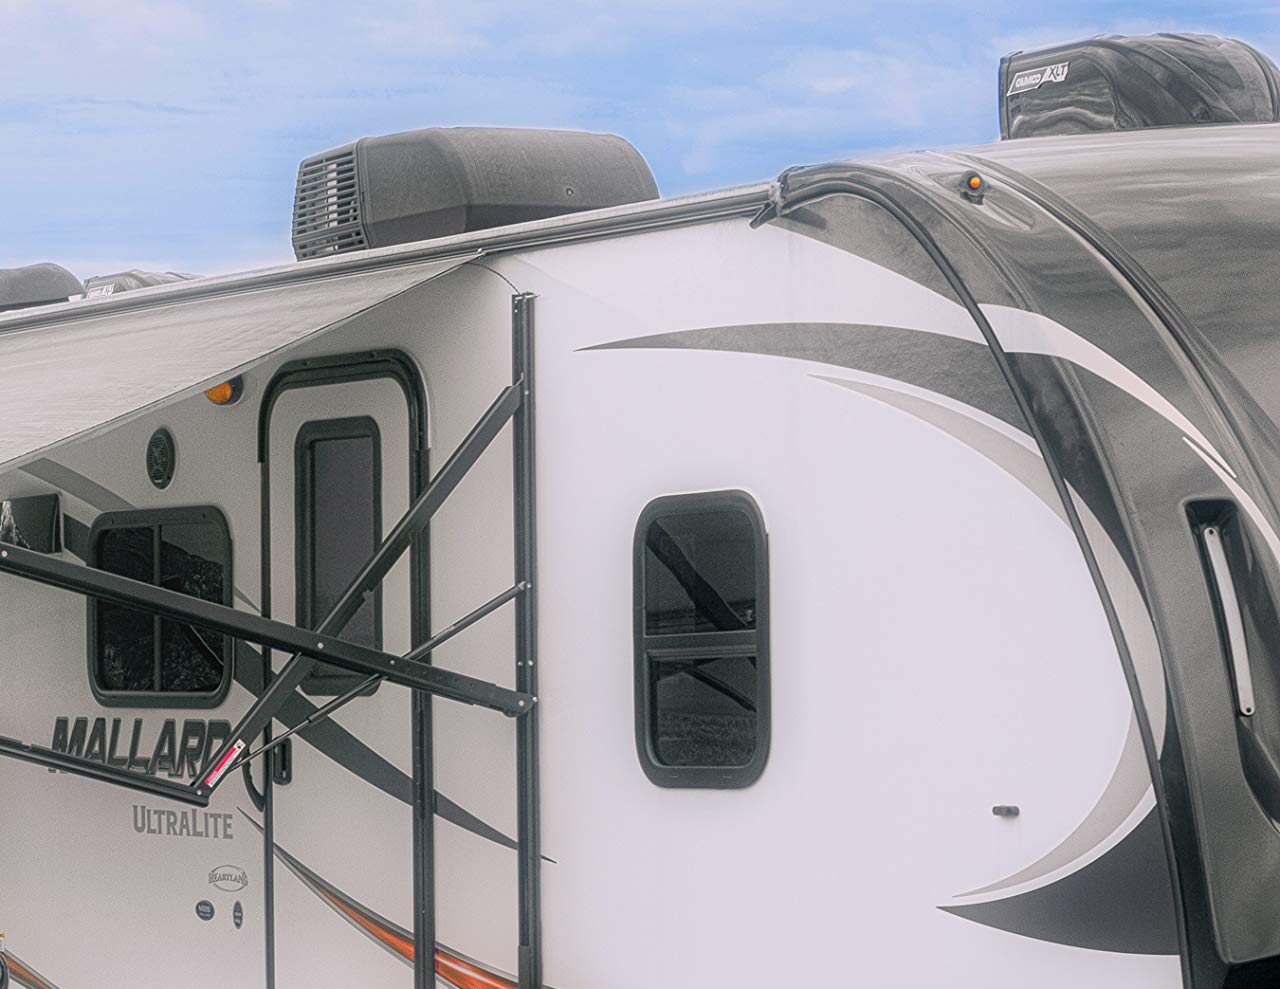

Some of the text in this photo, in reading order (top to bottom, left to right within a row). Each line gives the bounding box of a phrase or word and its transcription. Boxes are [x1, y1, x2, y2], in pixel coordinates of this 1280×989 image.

[1015, 64, 1068, 88] CAMCO XLT
[48, 716, 232, 779] MALLARD
